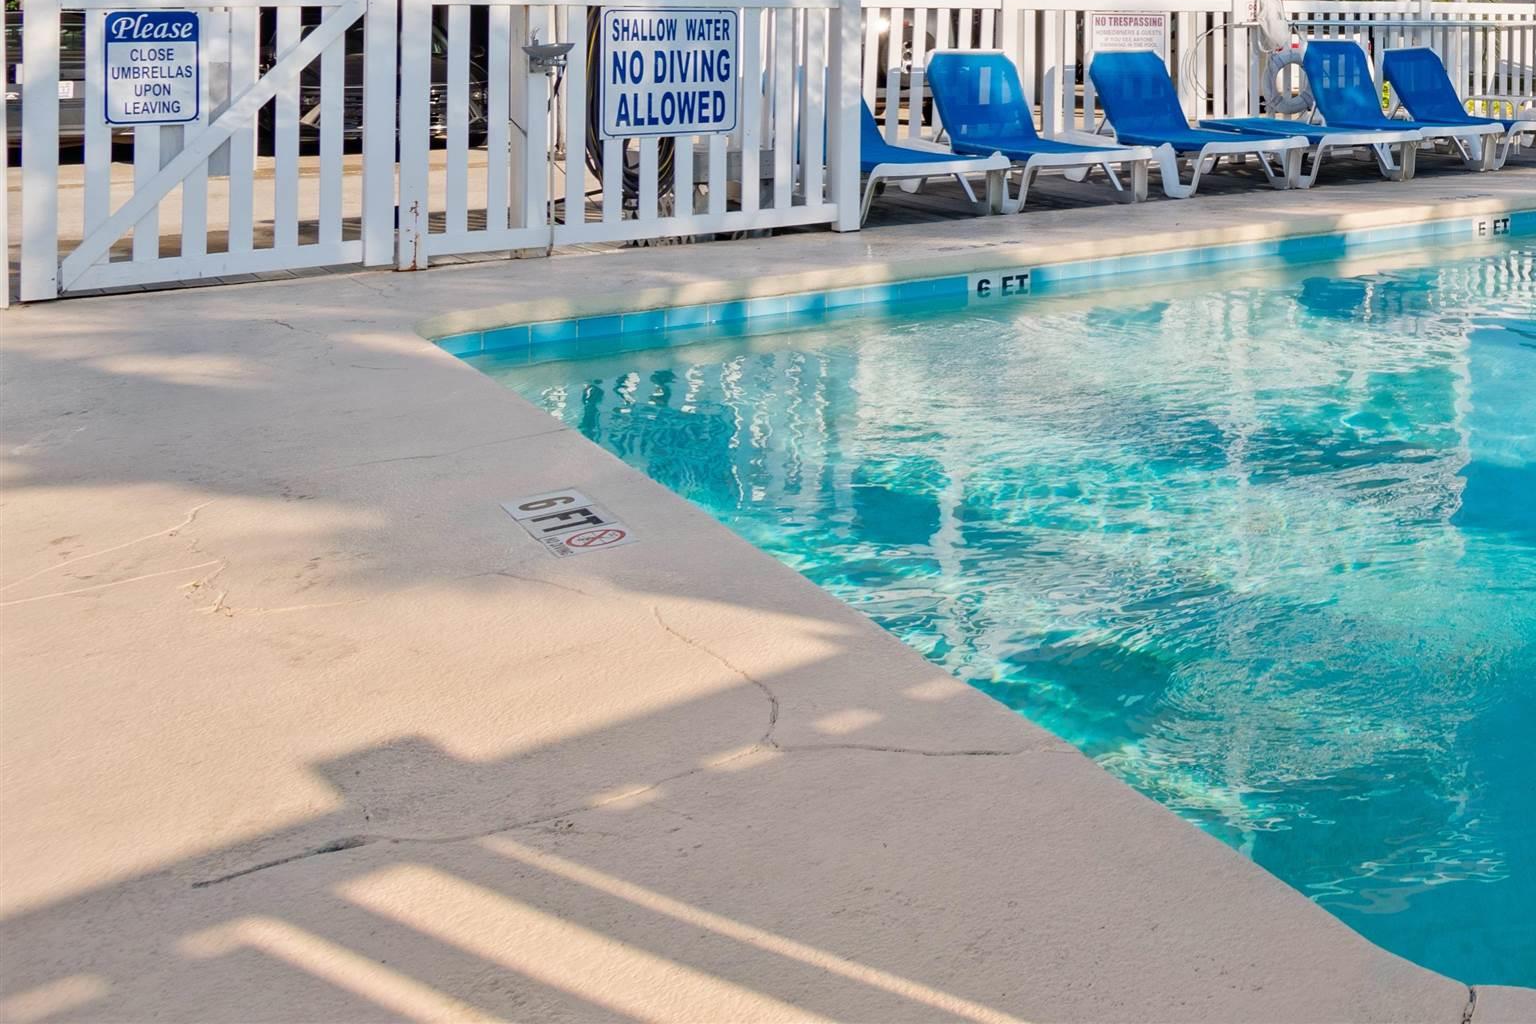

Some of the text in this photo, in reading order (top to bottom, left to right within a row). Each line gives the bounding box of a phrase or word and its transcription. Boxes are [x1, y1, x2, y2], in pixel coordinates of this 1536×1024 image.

[111, 13, 194, 39] Please
[612, 18, 730, 41] SHALLOW WATER
[1095, 16, 1163, 27] NO TRESPASSING
[130, 48, 174, 61] CLOSE
[111, 65, 193, 80] UMBRELLAS
[612, 49, 730, 84] NO DIVING
[134, 83, 171, 96] UPON
[124, 100, 181, 115] LEAVING
[615, 90, 726, 127] ALLOWED
[1001, 274, 1029, 296] FT
[518, 496, 604, 533] 6 FT
